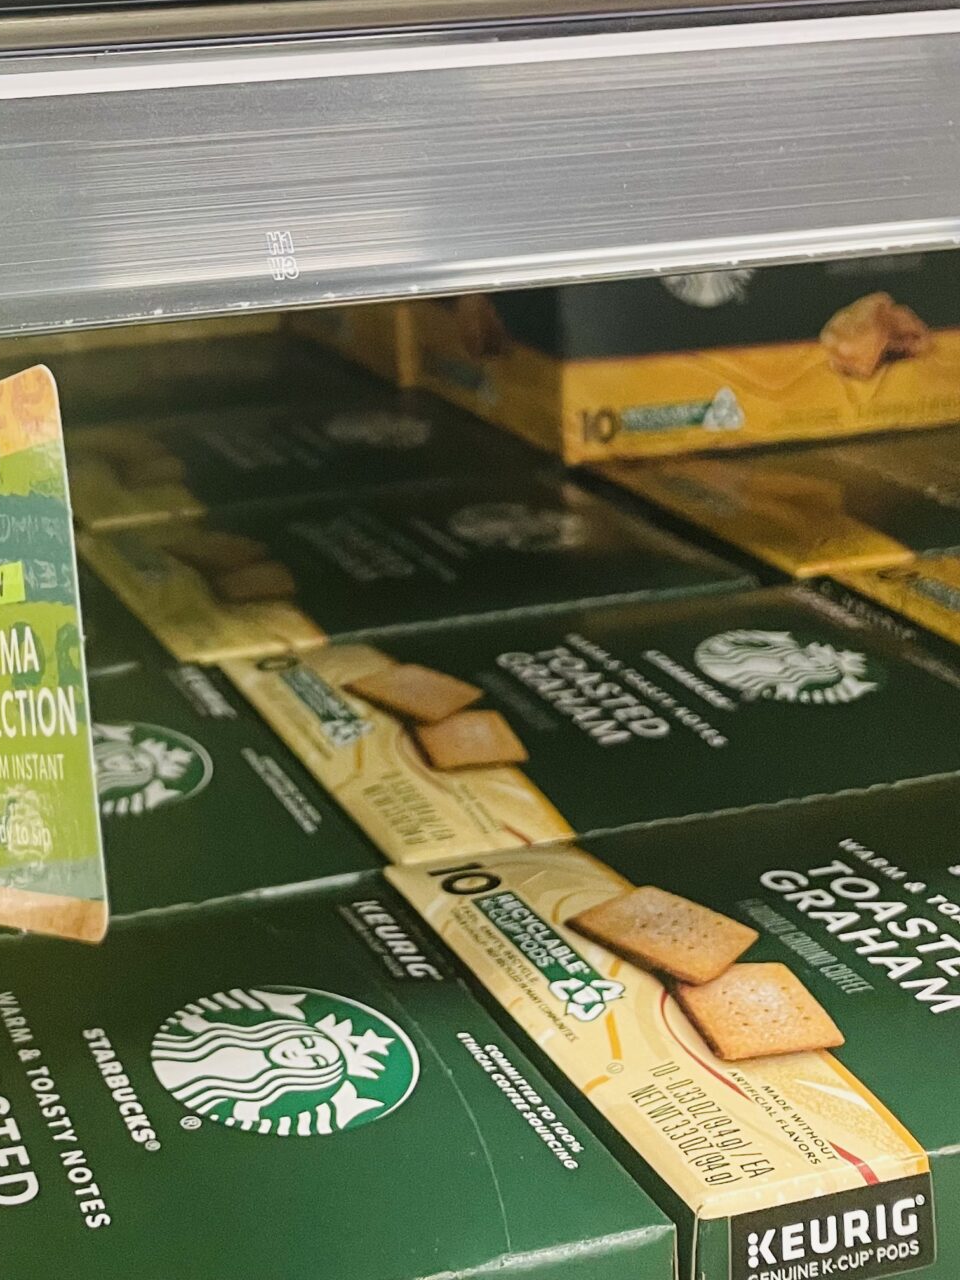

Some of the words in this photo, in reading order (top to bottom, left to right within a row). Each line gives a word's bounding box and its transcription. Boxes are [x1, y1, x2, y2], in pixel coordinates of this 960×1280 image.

[496, 651, 632, 745] GRAHAM
[535, 646, 670, 738] TOASTED
[12, 753, 65, 781] INSTANT
[16, 822, 29, 844] to
[427, 862, 502, 895] 10
[839, 838, 907, 881] WARM
[903, 881, 927, 893] &
[808, 859, 960, 977] TOAST
[513, 932, 555, 968] PODS
[759, 869, 960, 1014] GRAHAM
[779, 930, 838, 967] GROUND
[819, 963, 875, 995] COFFEE
[17, 1047, 41, 1062] &
[648, 1060, 681, 1078] 10
[26, 1065, 78, 1143] TOASTY
[456, 1032, 497, 1073] ETHICAL
[491, 1073, 531, 1111] COFFEE
[522, 1111, 579, 1170] SOURCING
[484, 1044, 543, 1104] COMMITTED
[537, 1105, 556, 1121] TO
[550, 1121, 585, 1153] 100%
[627, 1083, 667, 1108] NET
[666, 1078, 708, 1104] 0.33
[647, 1103, 685, 1124] WT
[687, 1100, 722, 1119] OZ
[727, 1071, 780, 1117] ARTIFICIAL
[776, 1119, 822, 1166] FLAVORS
[761, 1085, 793, 1113] MADE
[791, 1112, 839, 1161] WITHOUT
[662, 1119, 700, 1141] 3.3
[697, 1113, 741, 1138] (9.4
[678, 1136, 715, 1156] OZ
[715, 1136, 753, 1153] g)
[688, 1150, 731, 1173] (94
[740, 1158, 776, 1179] EA
[60, 1149, 111, 1230] NOTES
[704, 1171, 743, 1187] g)
[876, 1239, 920, 1263] PODS
